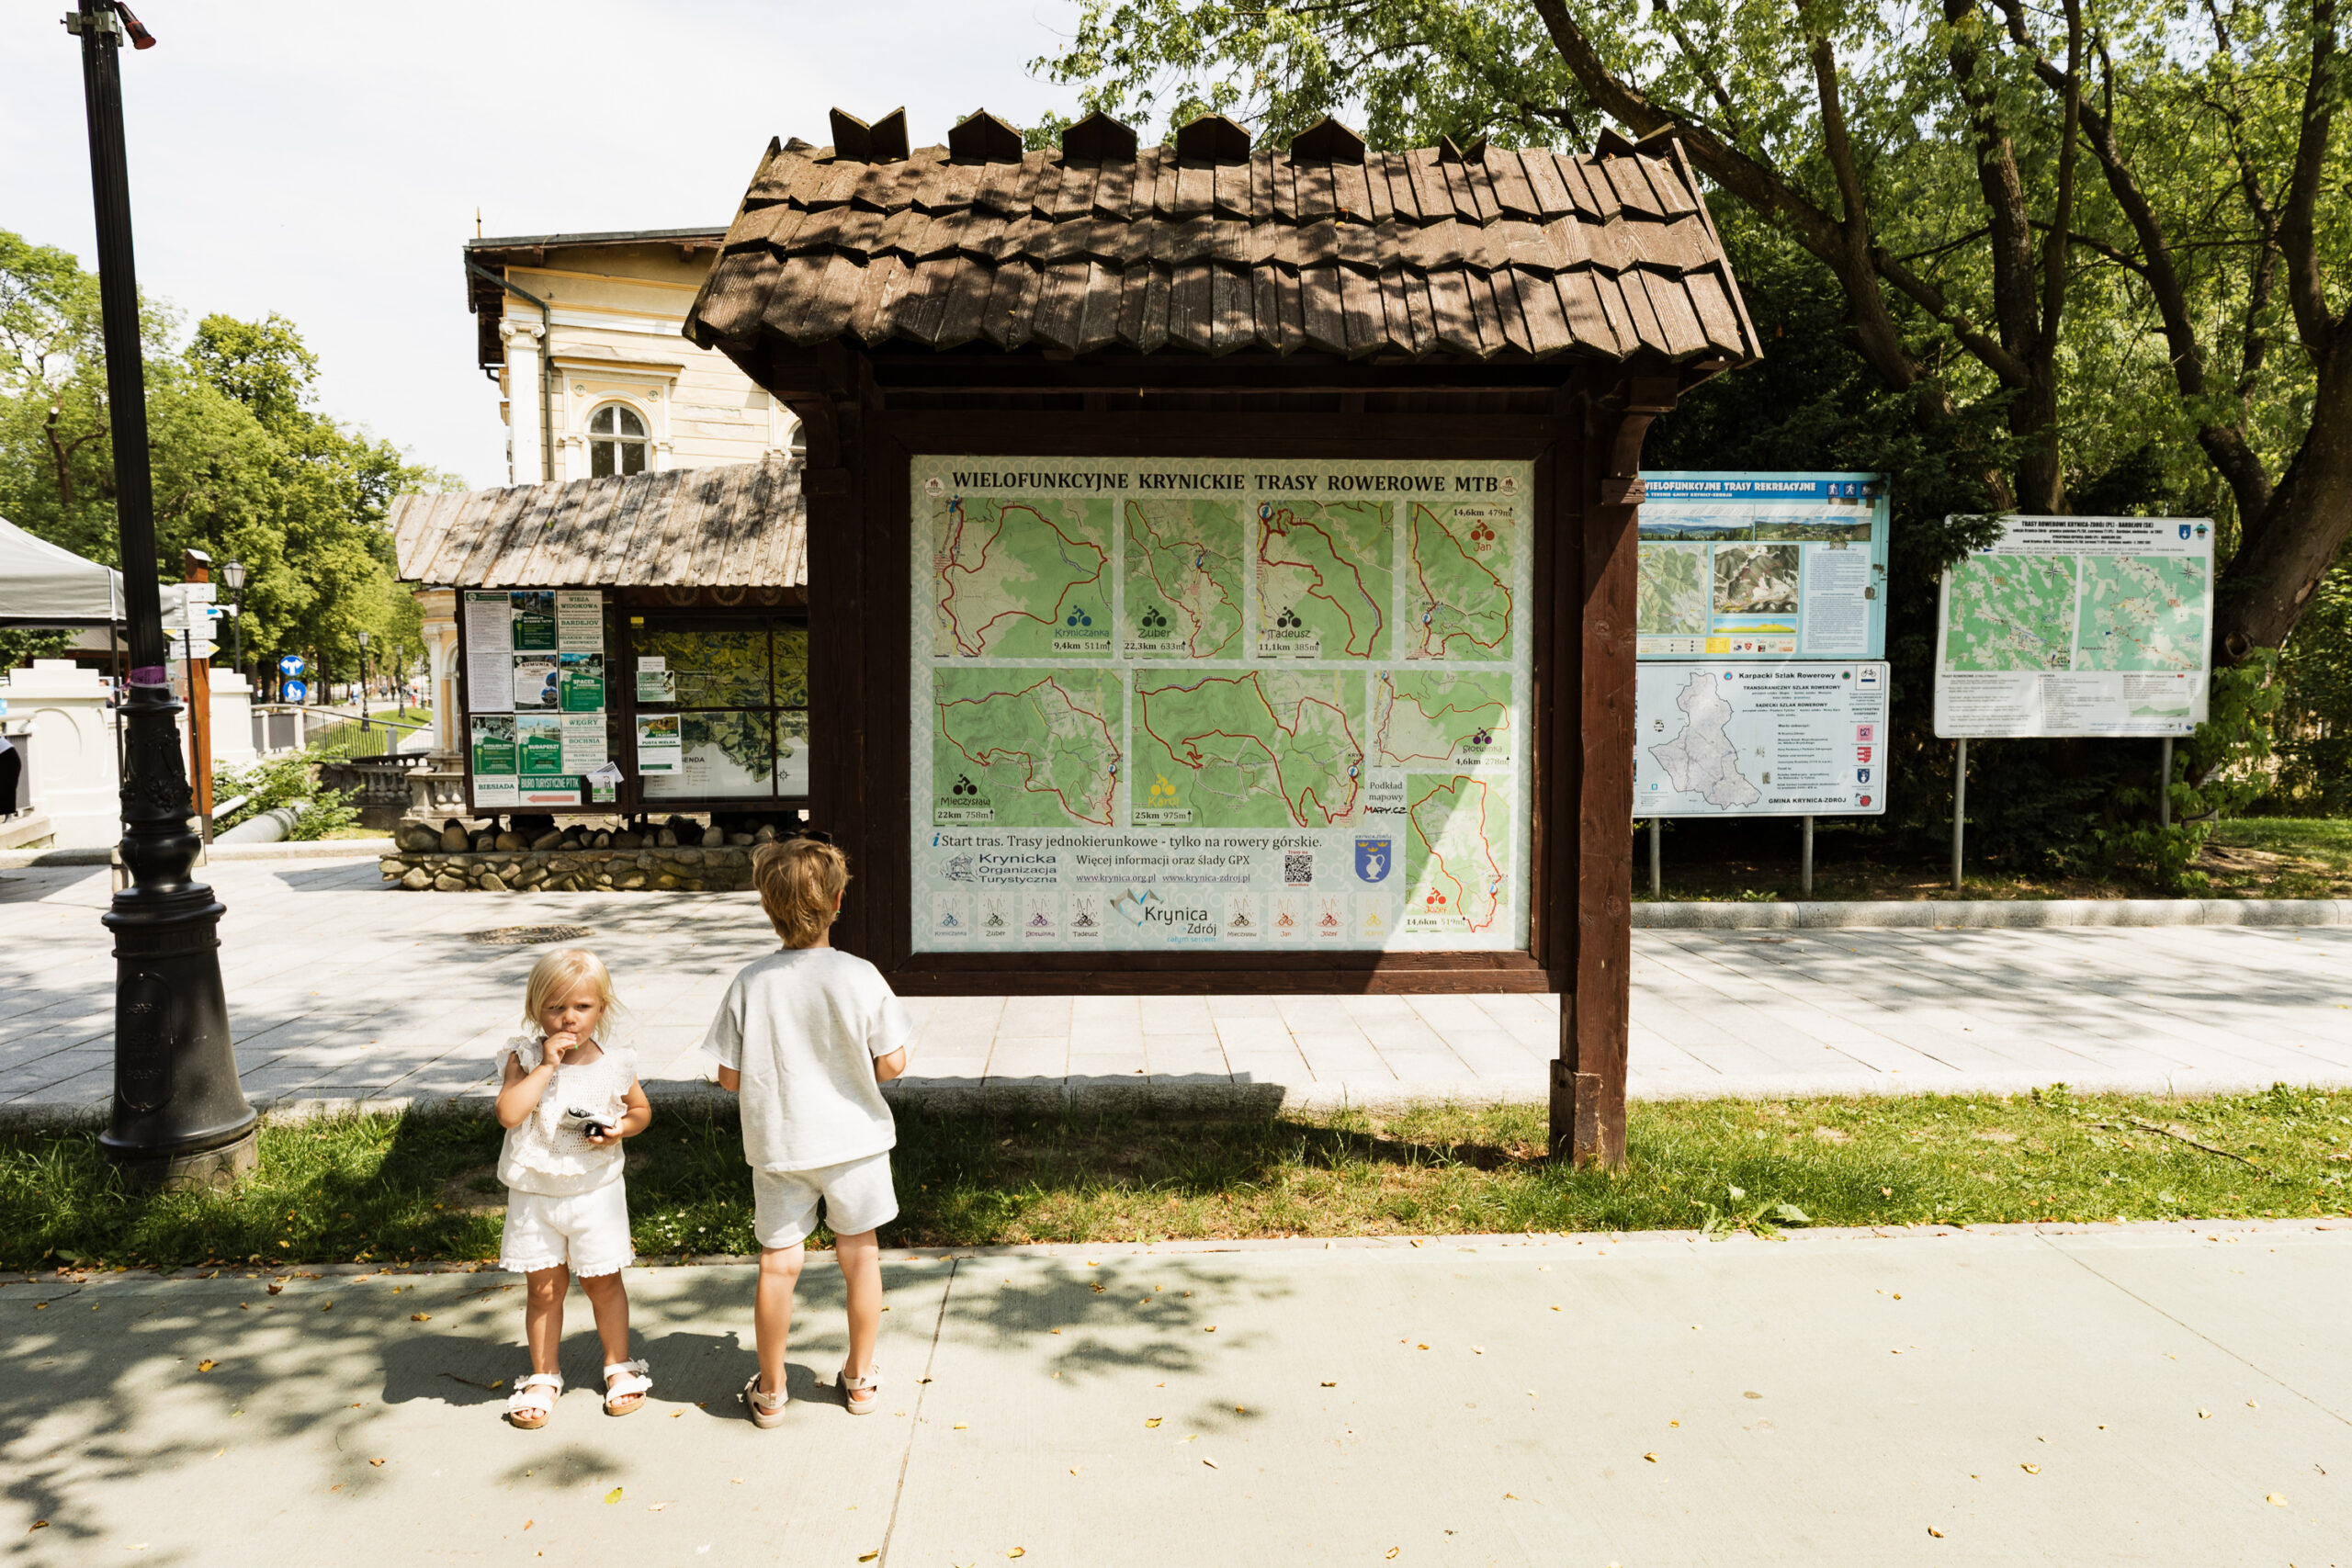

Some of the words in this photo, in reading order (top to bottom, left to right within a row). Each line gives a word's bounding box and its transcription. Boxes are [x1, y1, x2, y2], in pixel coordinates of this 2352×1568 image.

[953, 472, 1128, 491] WIELOFUNKCYJNE
[1139, 473, 1245, 490] KRYNICKIE
[1255, 474, 1318, 490] TRASY
[1328, 475, 1445, 491] ROWEROWE
[1455, 476, 1498, 492] MTB
[1724, 482, 1752, 491] TRASY
[1754, 482, 1816, 491] REKREACYJNE
[1453, 509, 1485, 517] 14,6km
[1487, 509, 1510, 517] 479m
[1474, 541, 1492, 552] Jan
[1055, 628, 1110, 639] Kryniczanka
[1268, 628, 1311, 638] Tadeusz
[1054, 641, 1080, 650] 9,4km
[1084, 642, 1108, 650] 511m
[1125, 642, 1157, 651] 22,3km
[1260, 643, 1290, 651] 11,1km
[1294, 643, 1317, 651] 385m
[1797, 671, 1836, 680] Rowerowy
[1455, 758, 1481, 766] 4,6km
[1370, 782, 1403, 790] Podkład
[1148, 795, 1180, 807] Karol
[1369, 794, 1403, 803] mapowy
[937, 811, 961, 819] 22km
[942, 835, 973, 846] Start
[976, 836, 1003, 846] tras.
[1007, 835, 1043, 849] Trasy
[1046, 835, 1158, 849] jednokierunkowe
[1170, 835, 1201, 850] tylko
[1204, 839, 1220, 847] na
[1224, 839, 1269, 850] rowery
[1272, 836, 1323, 850] górskie.
[979, 853, 1056, 865] Krynicka
[1076, 854, 1112, 866] Więcej
[1114, 855, 1169, 867] informacji
[1172, 857, 1194, 865] oraz
[1198, 855, 1226, 867] ślady
[1228, 855, 1250, 865] GPX
[978, 866, 1057, 875] Organizacja
[979, 875, 1057, 885] Turystyczna
[1076, 874, 1156, 883] www.krynica.org.pl
[1162, 874, 1250, 883] www.krynica-zdroj.pl
[1145, 906, 1207, 925] Krynica
[1407, 918, 1437, 927] 14,6km
